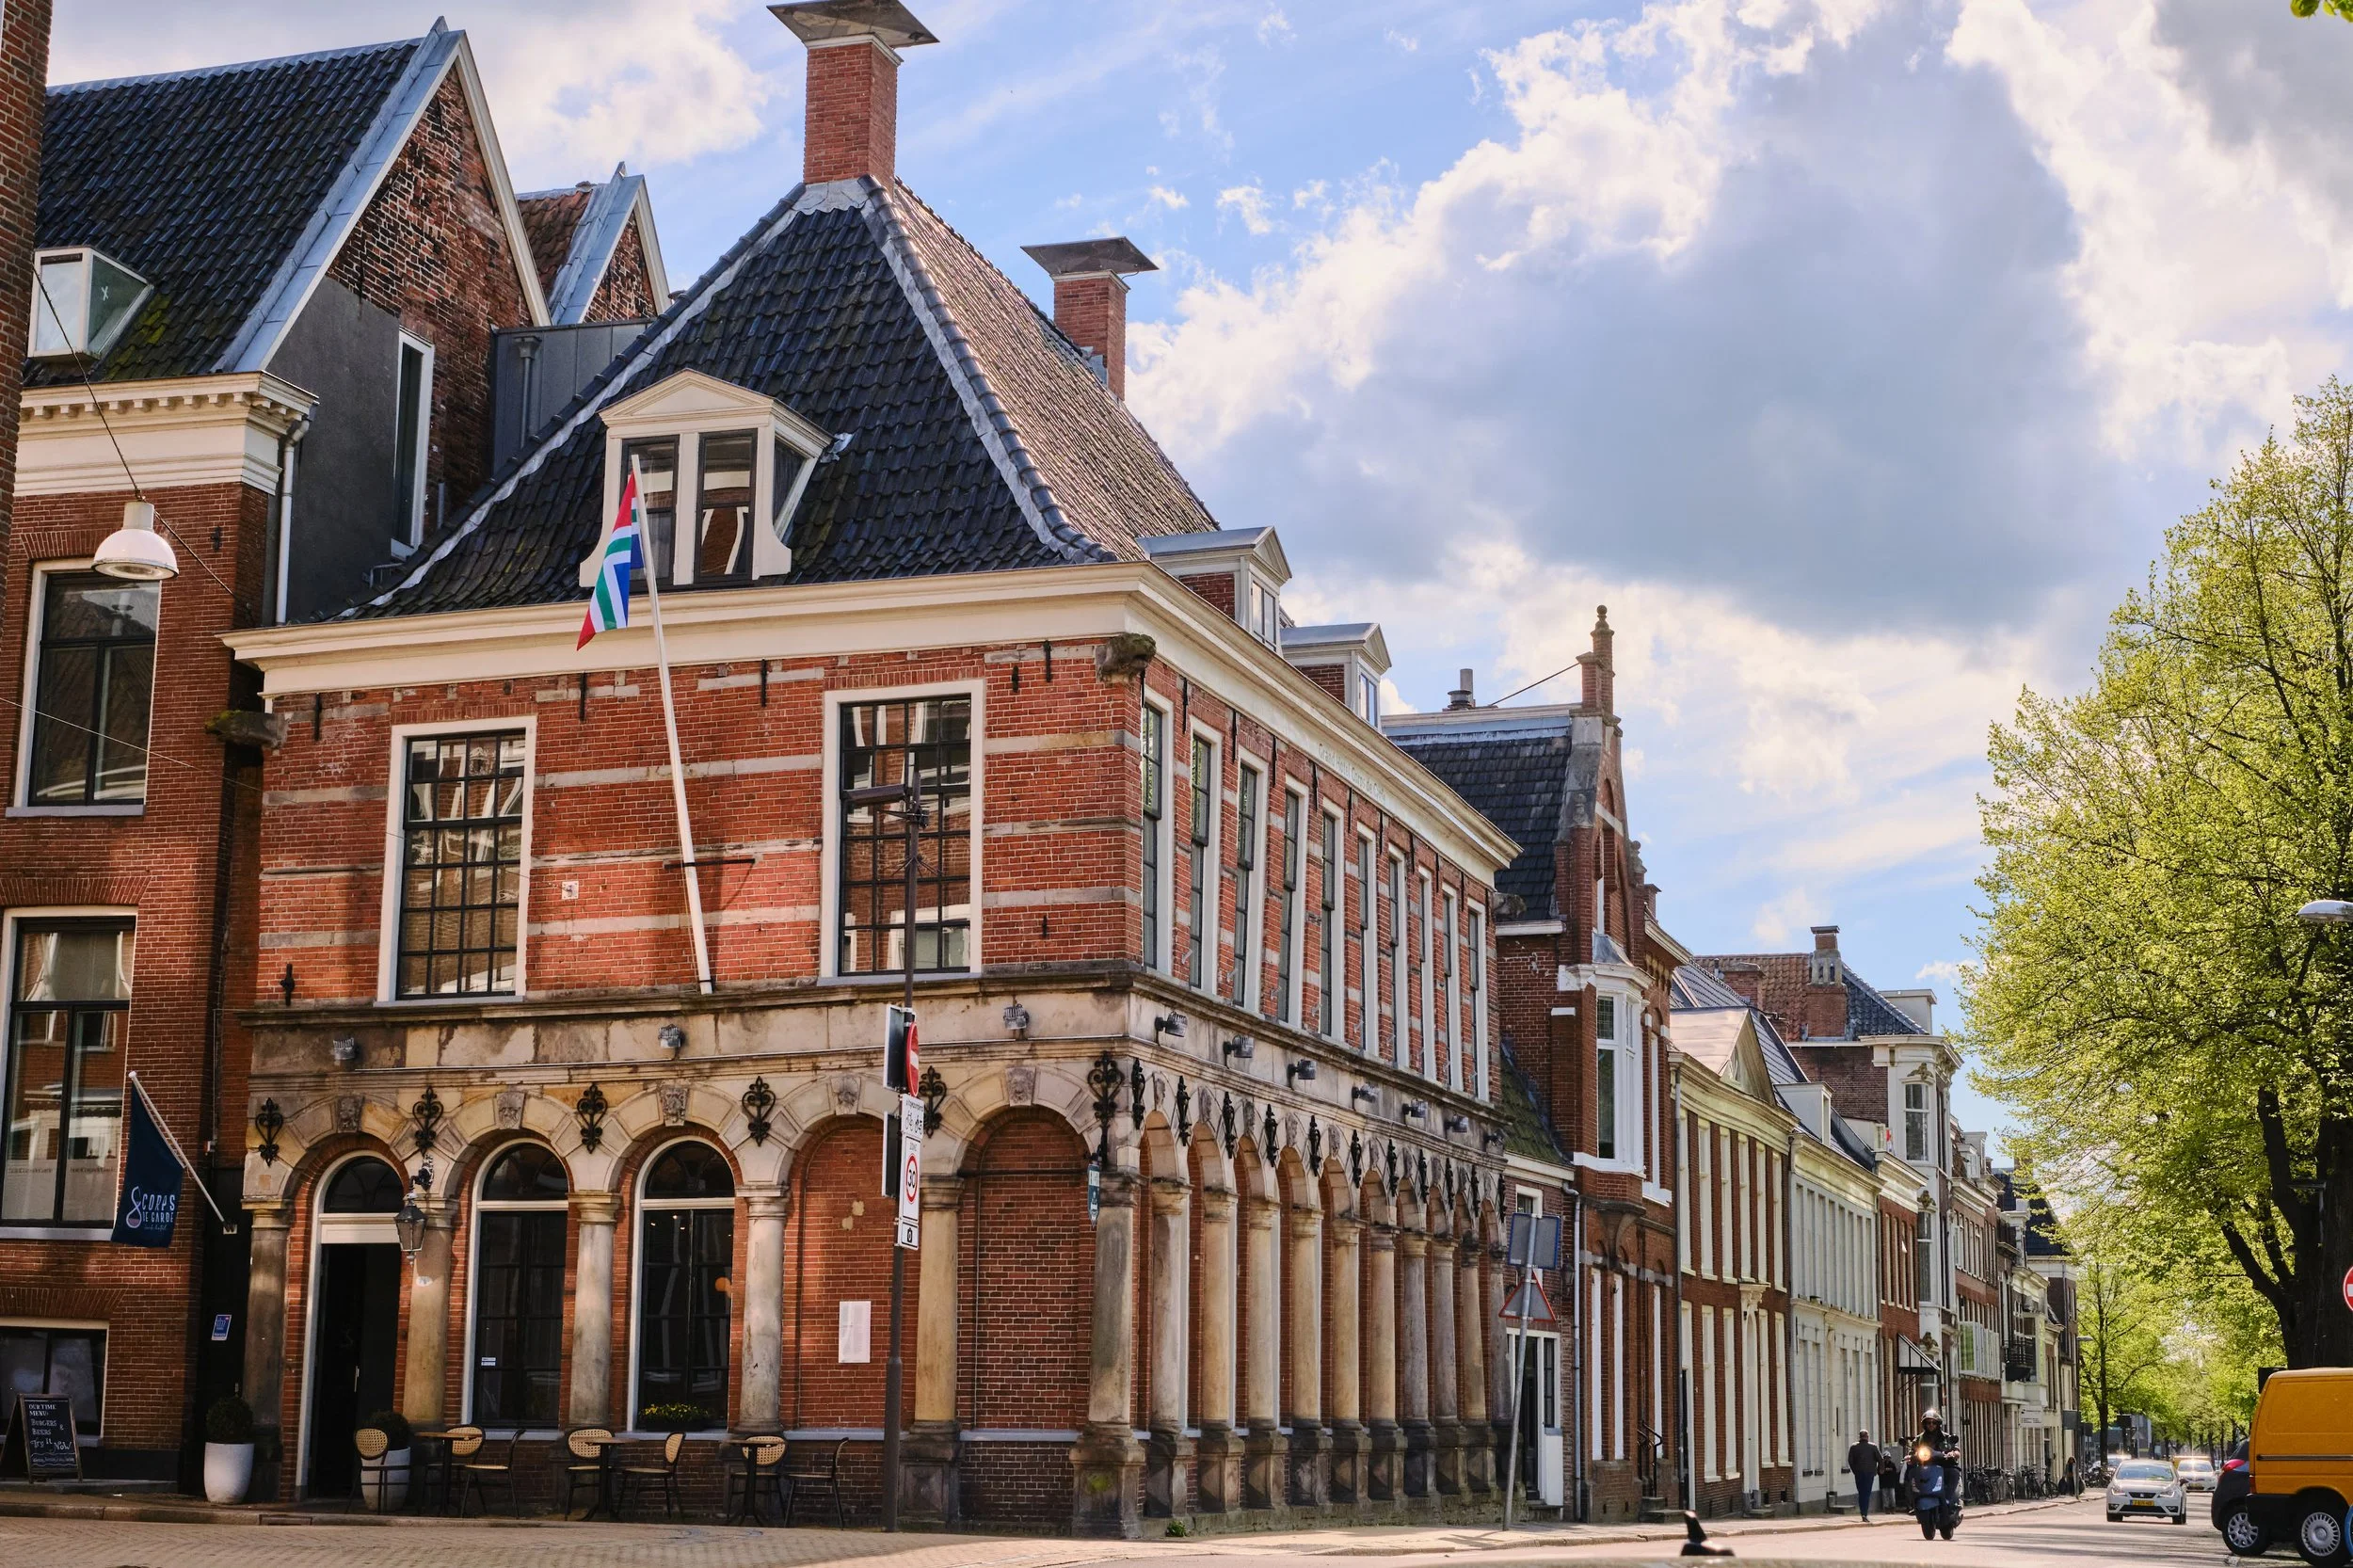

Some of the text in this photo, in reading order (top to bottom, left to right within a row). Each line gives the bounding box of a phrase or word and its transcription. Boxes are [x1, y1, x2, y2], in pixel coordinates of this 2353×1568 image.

[908, 1169, 916, 1189] 30
[142, 1193, 175, 1211] CORPS
[151, 1211, 173, 1223] GARDE
